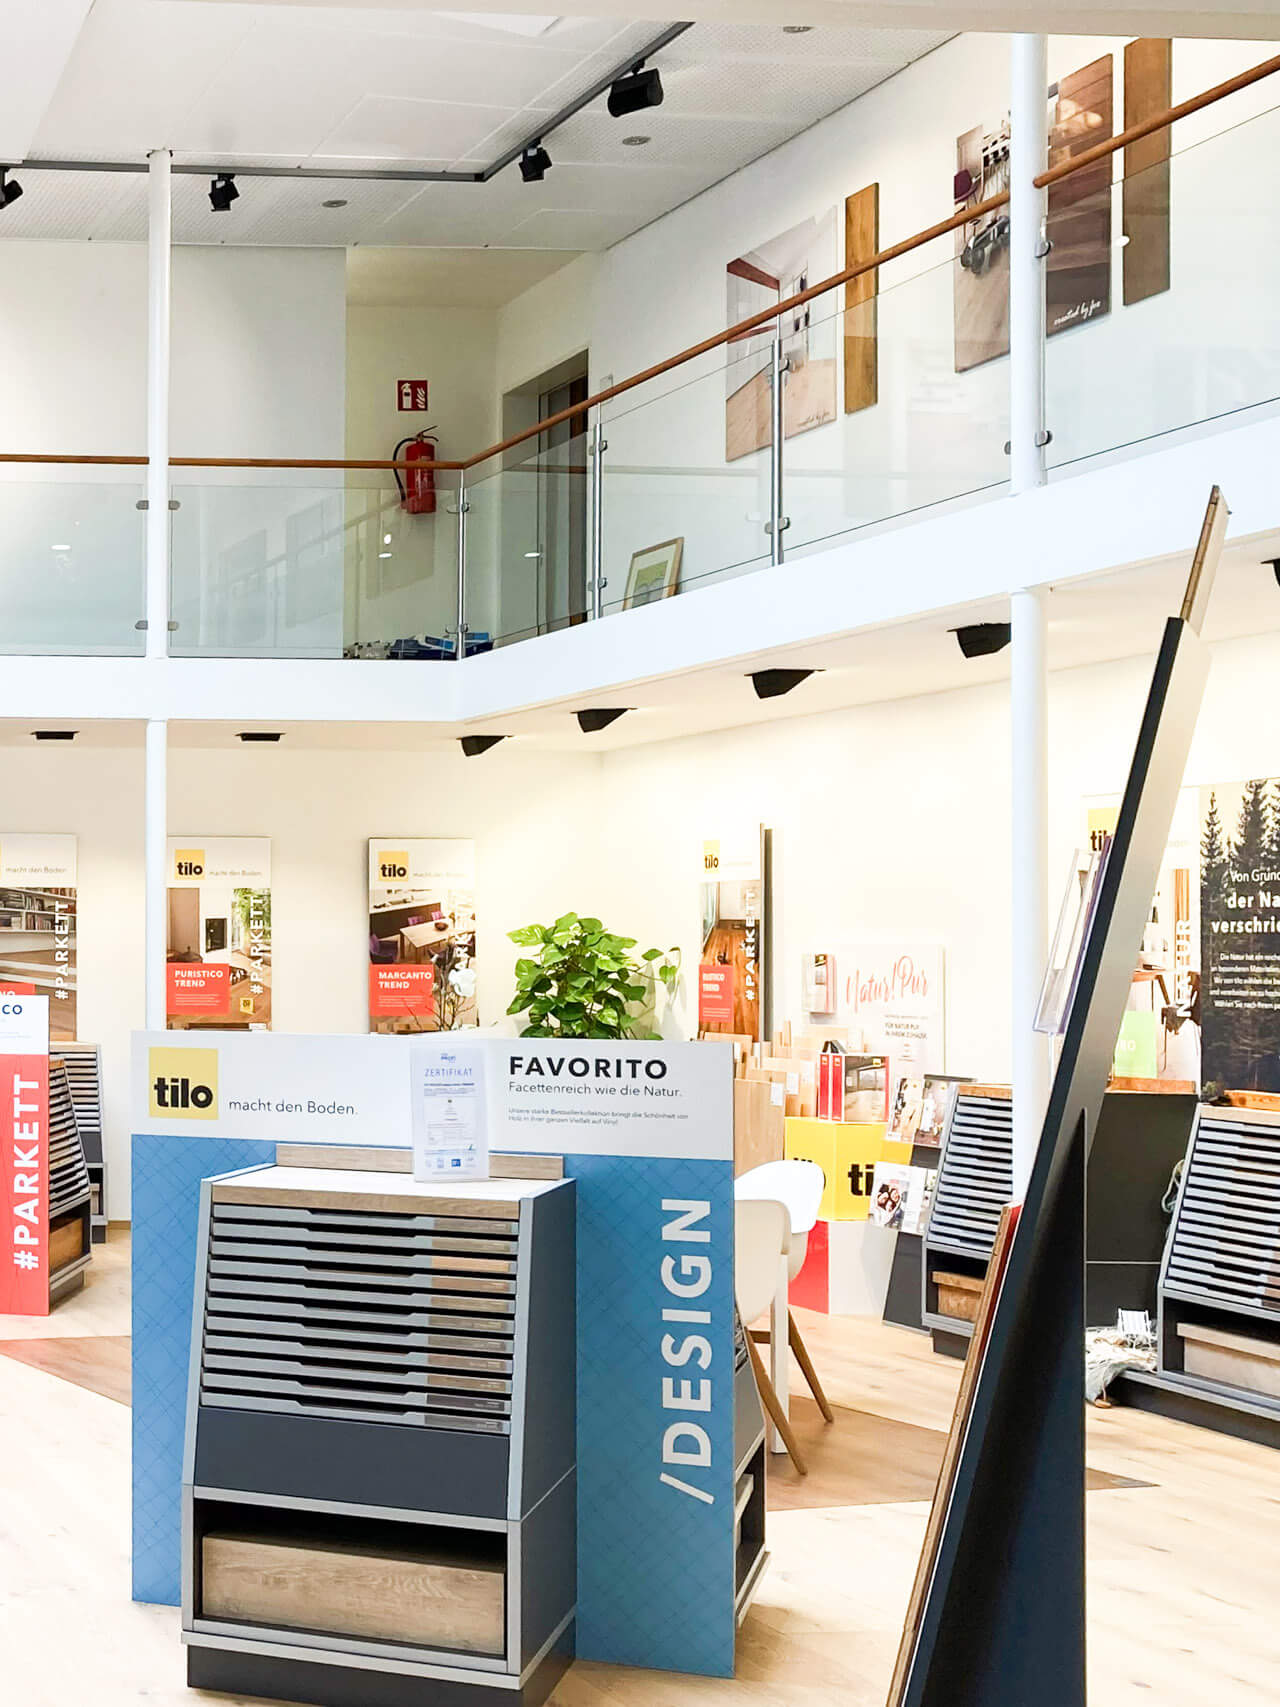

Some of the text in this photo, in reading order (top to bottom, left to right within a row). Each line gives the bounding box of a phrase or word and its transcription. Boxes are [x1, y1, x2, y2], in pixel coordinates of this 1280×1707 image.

[177, 862, 203, 876] tilo
[381, 864, 407, 878] tilo
[1230, 868, 1250, 882] Von
[1227, 891, 1255, 910] der
[55, 900, 69, 1000] #PARKETT
[250, 896, 264, 995] #PARKETT
[175, 969, 224, 978] PURISTICO
[378, 971, 432, 980] MARCANTO
[175, 979, 206, 987] TREND
[379, 981, 409, 989] TREND
[424, 1067, 472, 1077] ZERTIFIKAT
[509, 1056, 668, 1081] FAVORITO
[153, 1077, 358, 1115] tilo macht den Boden.
[508, 1082, 683, 1098] Facettenreich wie die Natur.
[13, 1074, 40, 1270] #PARKETT
[659, 1198, 716, 1505] /DESIGN
